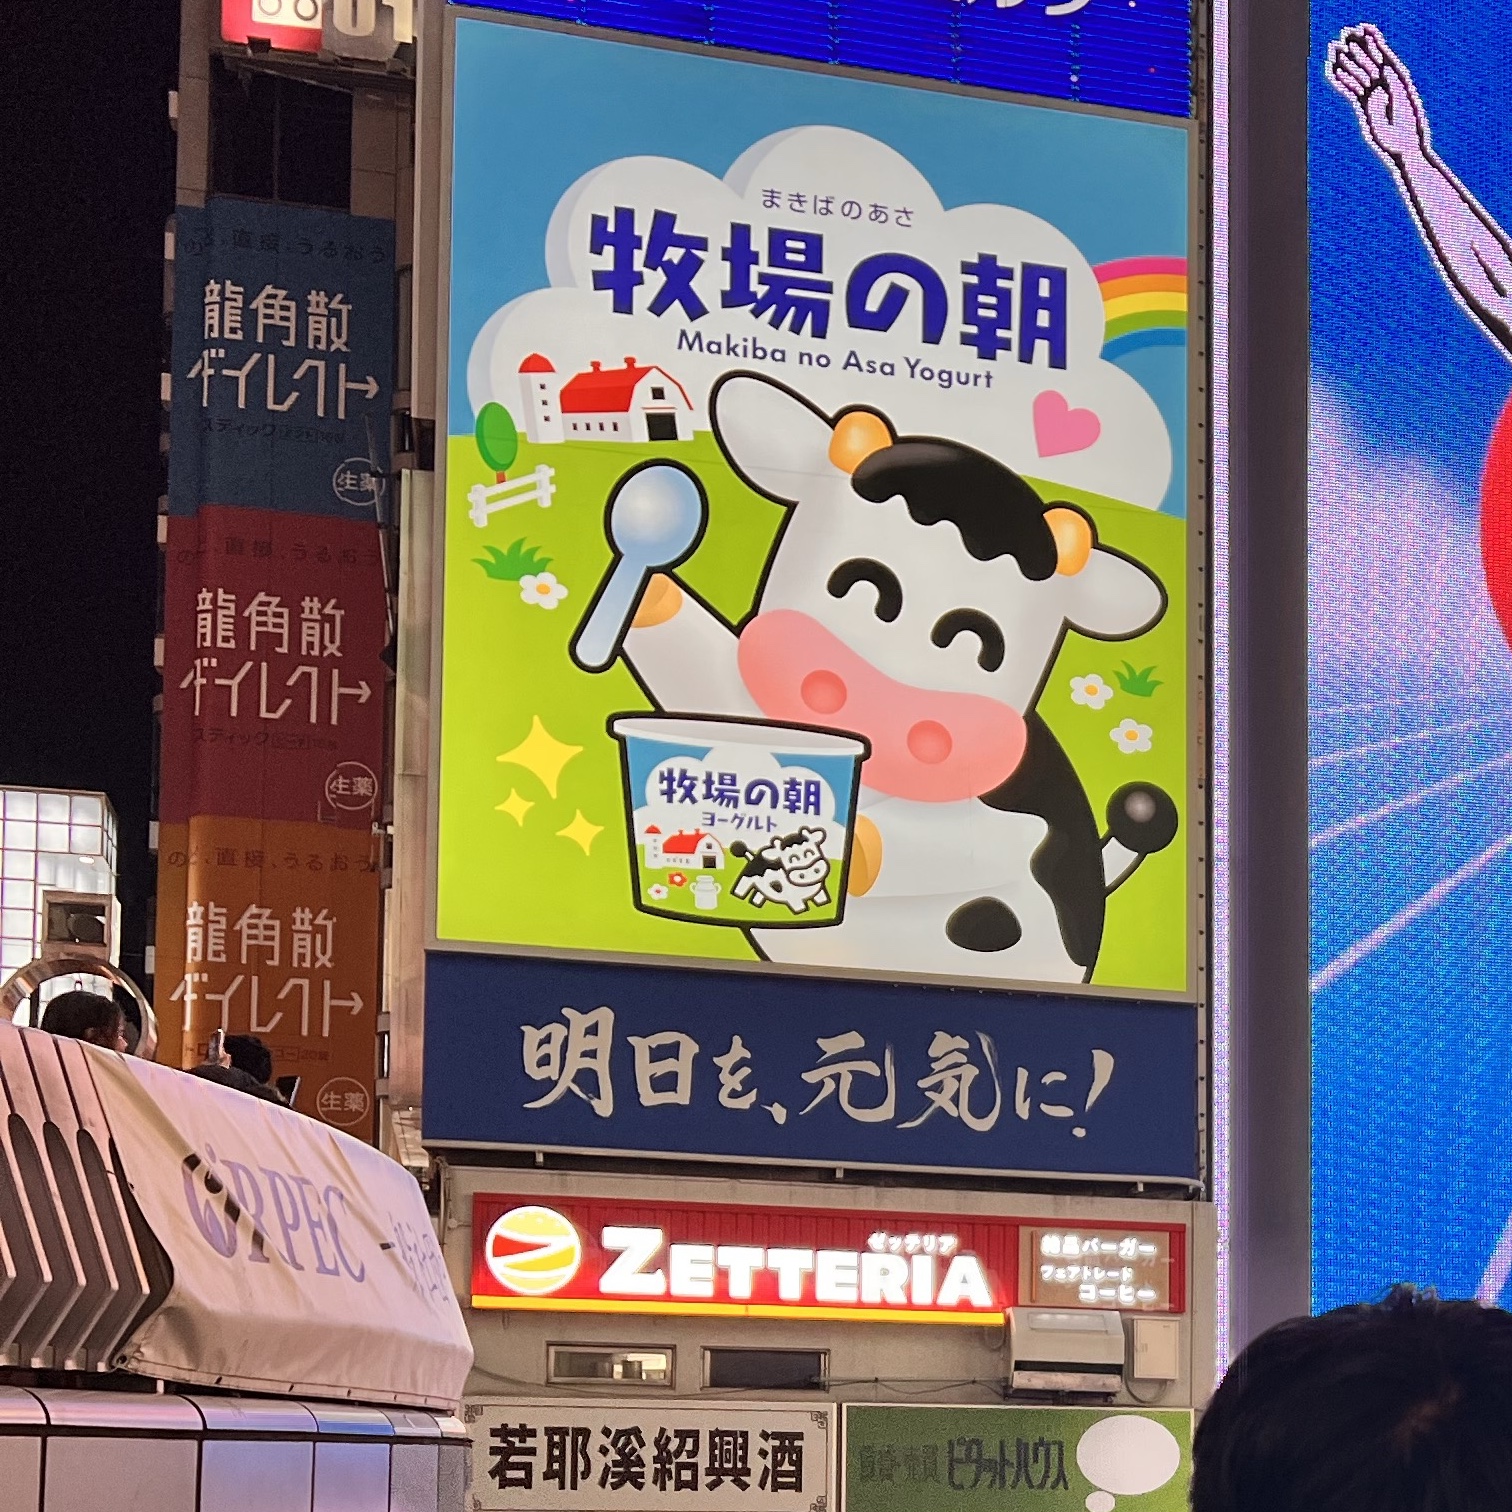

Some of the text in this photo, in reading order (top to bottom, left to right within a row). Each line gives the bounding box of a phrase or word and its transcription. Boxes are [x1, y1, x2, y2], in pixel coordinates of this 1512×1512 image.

[761, 188, 915, 229] まきばのあさ
[203, 279, 353, 352] 龍角散
[589, 205, 1068, 370] 牧場の朝
[677, 330, 994, 391] Makiba no Asa Yogurt
[196, 587, 345, 657] 龍角散
[659, 767, 821, 815] 牧場の朝
[702, 811, 778, 832] ヨーグルト
[186, 901, 337, 970] 龍角散
[599, 1225, 994, 1308] ZETTERIA
[1079, 1284, 1157, 1304] コーヒー
